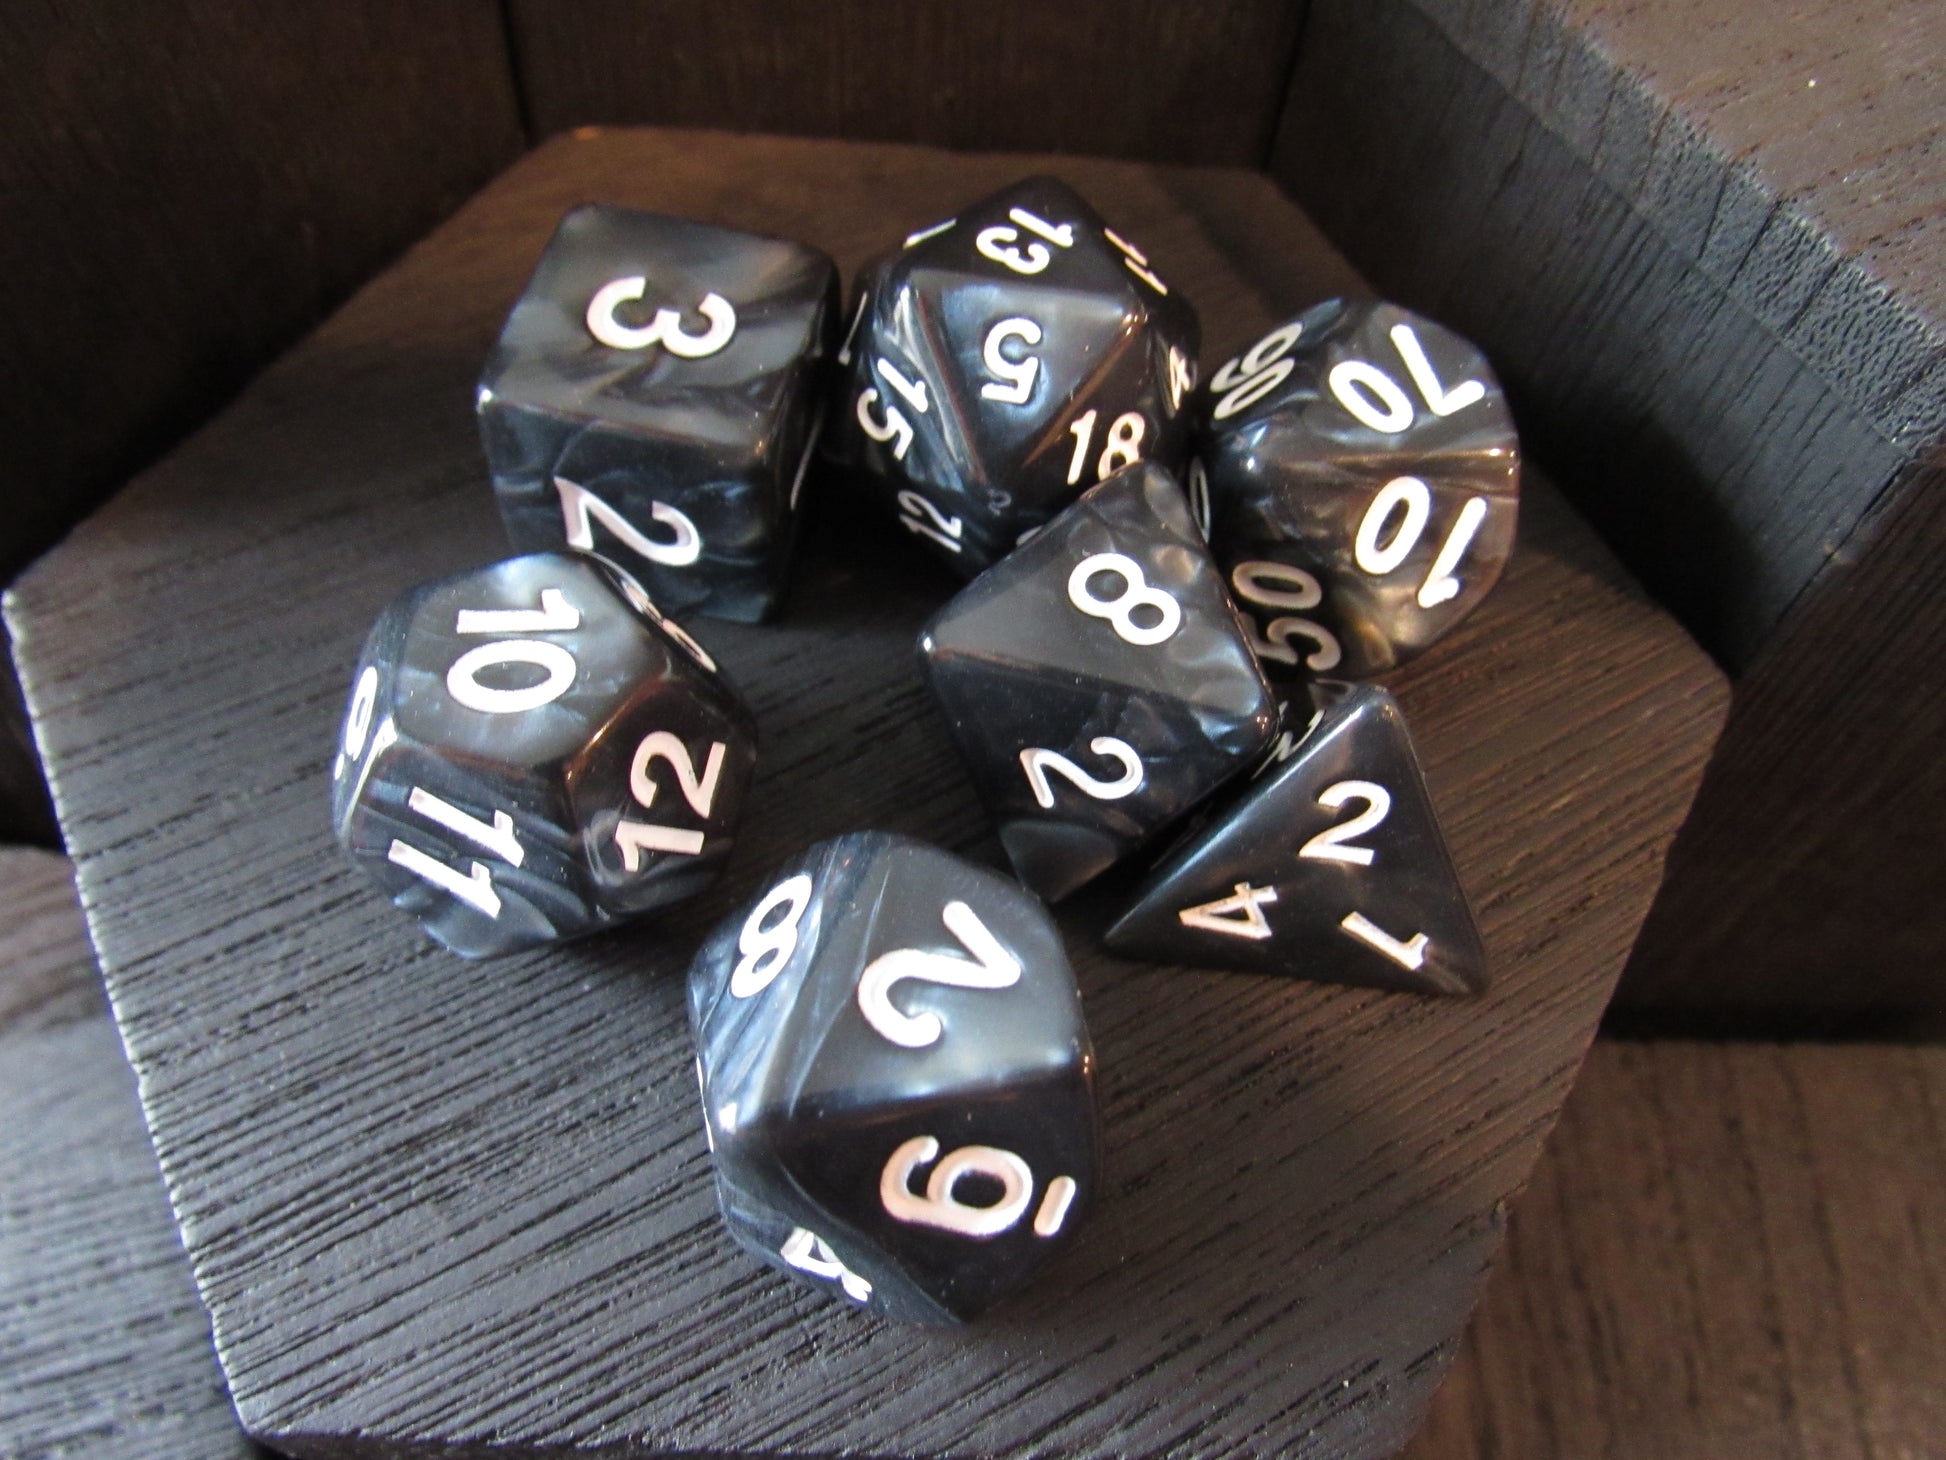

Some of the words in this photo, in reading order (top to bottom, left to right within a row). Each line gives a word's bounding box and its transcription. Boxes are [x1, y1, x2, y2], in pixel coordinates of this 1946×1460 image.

[976, 207, 1074, 275] 13
[587, 276, 737, 358] 3
[983, 317, 1042, 404] 5
[857, 357, 928, 460] 15
[1329, 324, 1486, 433] 70
[1067, 408, 1146, 485] 18
[553, 475, 700, 567] 2
[898, 490, 962, 553] 12
[1355, 476, 1487, 608] 10
[1068, 552, 1181, 646] 8
[1232, 561, 1342, 671] 50
[447, 588, 580, 713] 10
[615, 731, 727, 872] 12
[1020, 736, 1144, 809] 2
[388, 786, 525, 920] 11
[1299, 780, 1391, 866] 2
[731, 875, 813, 999] 8
[1179, 881, 1279, 939] 4
[1341, 911, 1430, 971] 1
[858, 901, 1022, 1048] 2
[780, 1227, 873, 1303] 4
